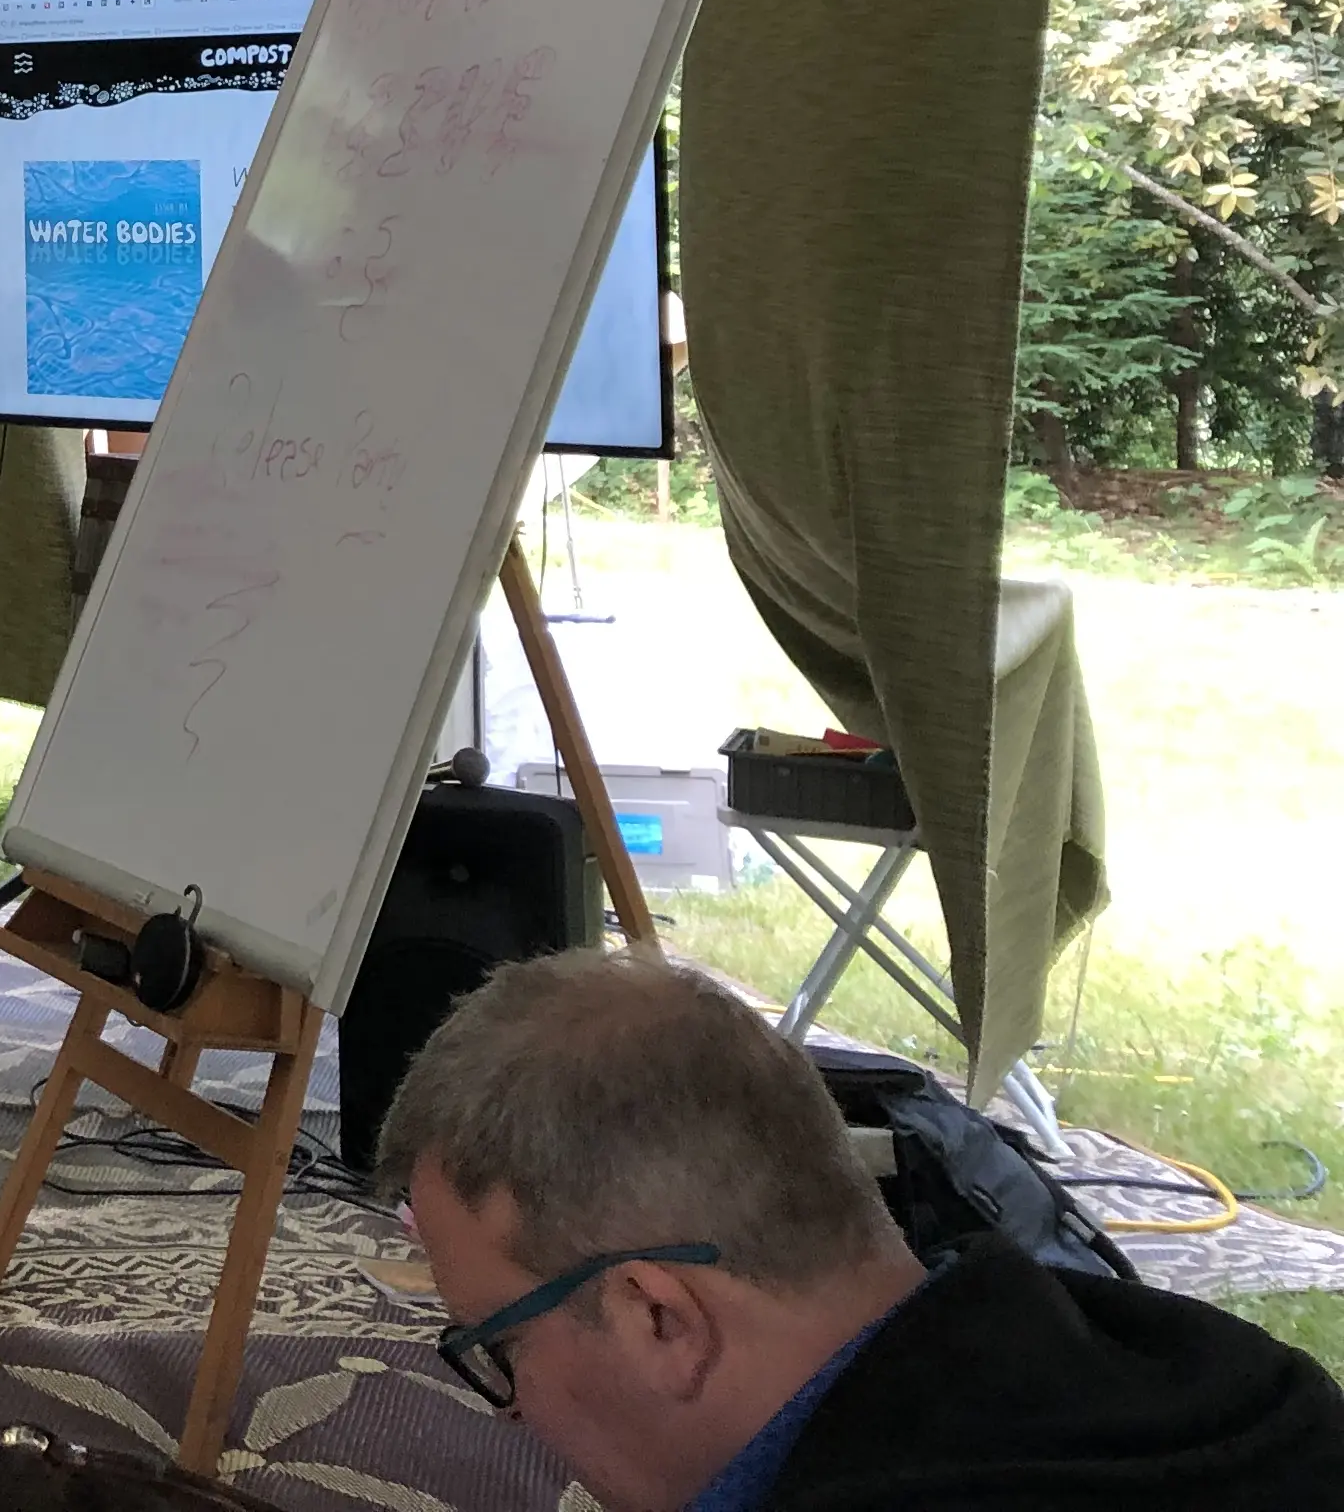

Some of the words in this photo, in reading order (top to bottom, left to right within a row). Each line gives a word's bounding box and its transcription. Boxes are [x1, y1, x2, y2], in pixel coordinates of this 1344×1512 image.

[200, 43, 292, 67] COMPOST
[28, 219, 109, 244] WATER
[116, 220, 196, 244] BODIES
